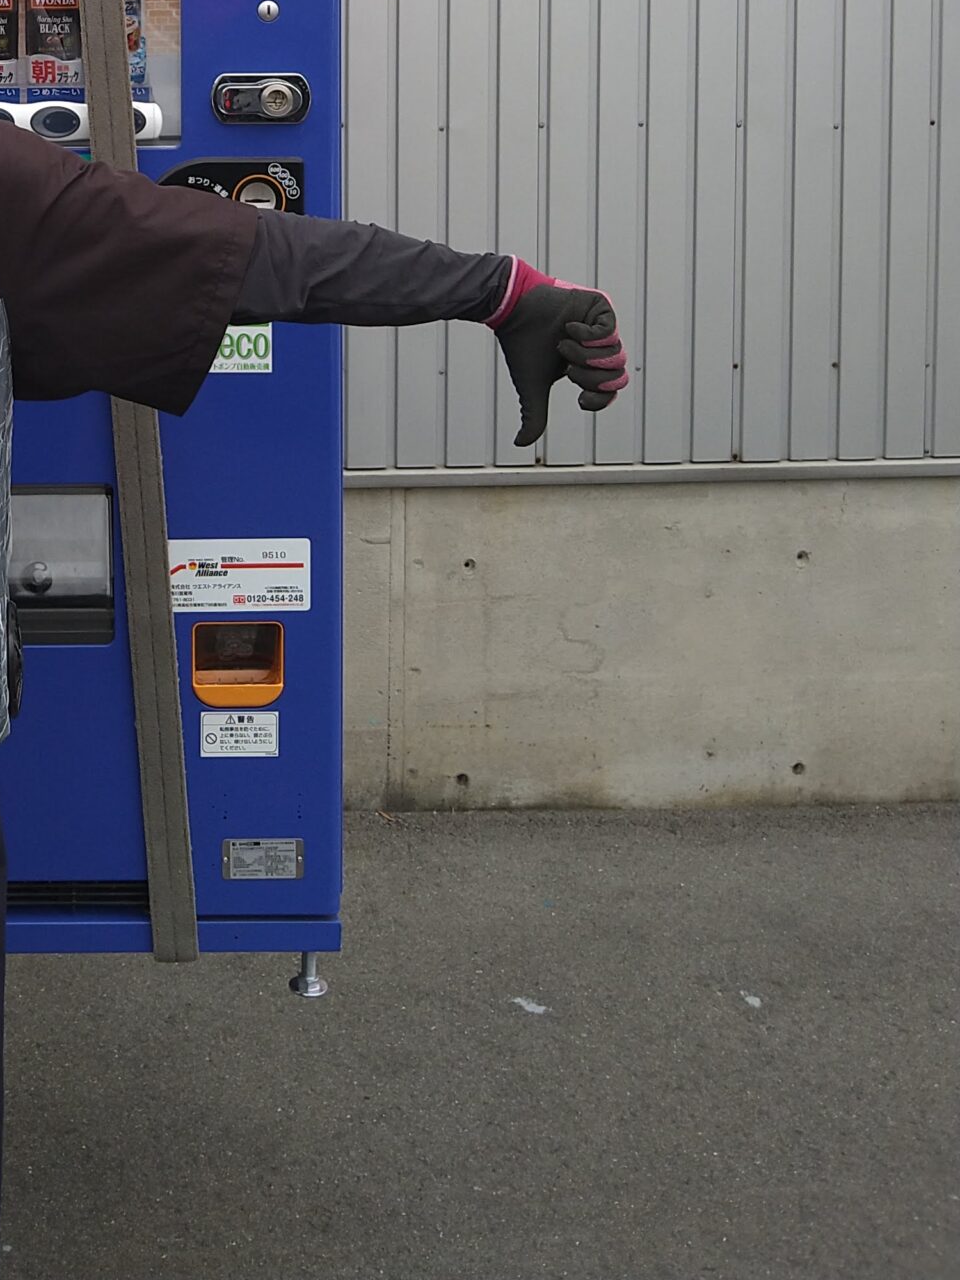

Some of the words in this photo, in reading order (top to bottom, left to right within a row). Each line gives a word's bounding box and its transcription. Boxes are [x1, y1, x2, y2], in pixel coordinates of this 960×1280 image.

[40, 23, 70, 34] BLACK
[31, 59, 57, 85] 朝
[57, 73, 79, 83] ブラック
[289, 188, 298, 196] 10
[219, 332, 271, 361] eco
[262, 551, 286, 559] 9510
[198, 561, 219, 569] West
[195, 569, 228, 577] Alliance
[246, 594, 304, 603] 0120-454-248
